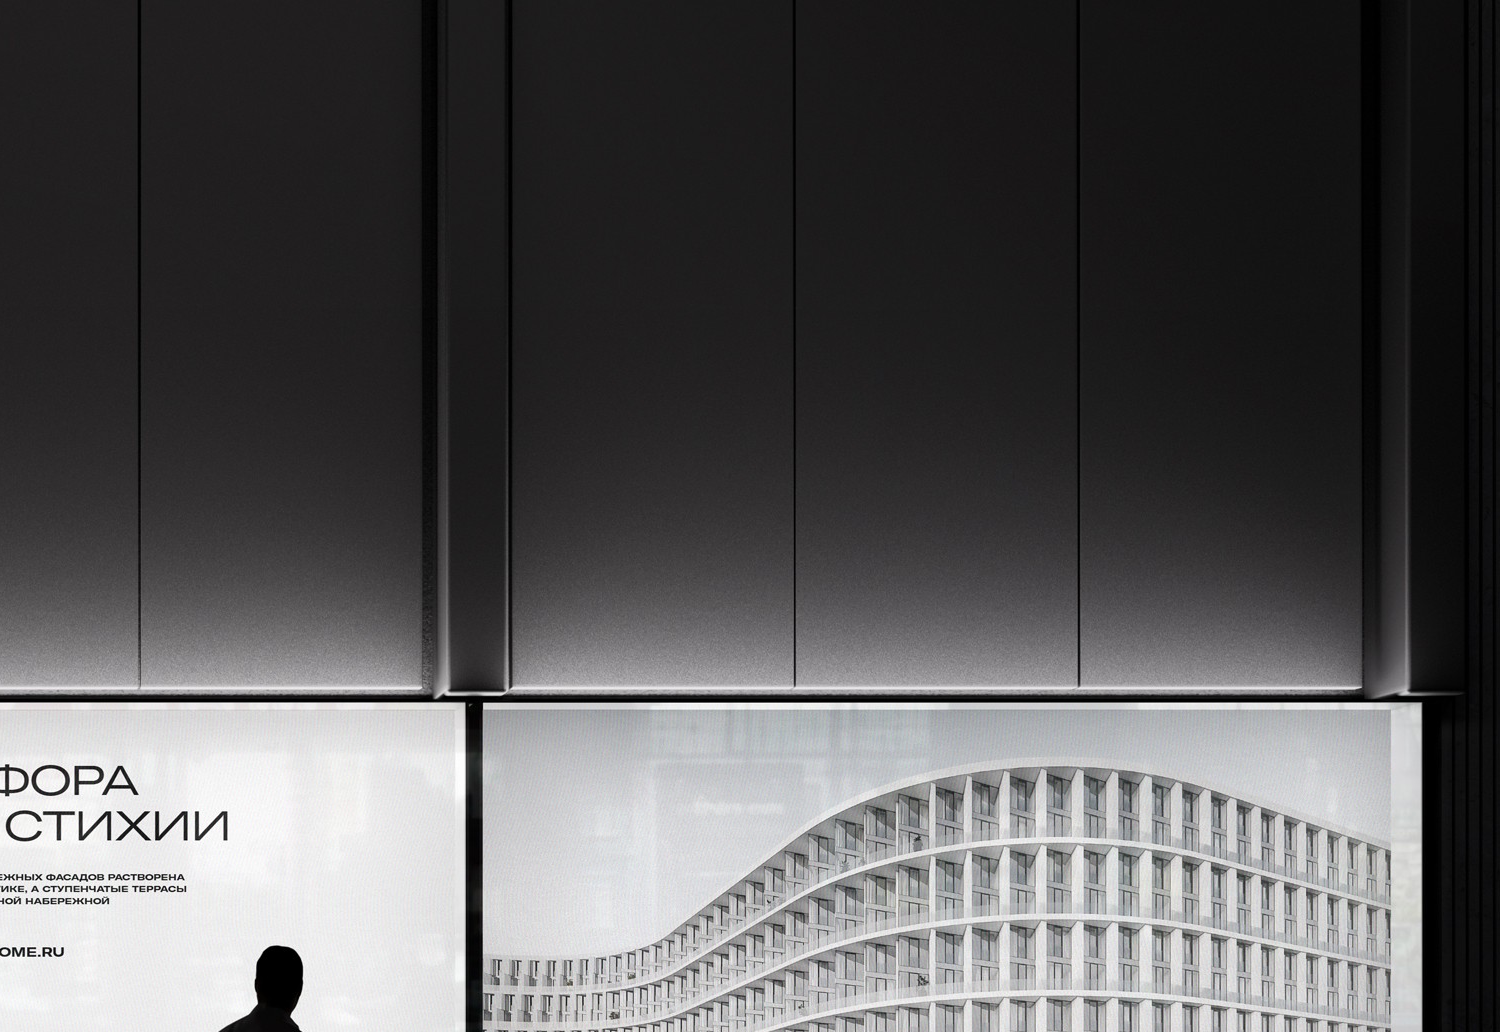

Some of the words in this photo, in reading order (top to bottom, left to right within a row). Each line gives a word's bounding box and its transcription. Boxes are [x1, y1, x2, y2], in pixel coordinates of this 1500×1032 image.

[5, 809, 229, 842] СТИХИИ
[45, 873, 105, 883] ФАСАДОВ
[107, 873, 186, 882] РАСТВОРЕНА
[30, 885, 40, 893] А
[42, 885, 129, 893] СТУПЕНЧАТЫЕ
[131, 885, 187, 893] ТЕРРАСЫ
[25, 896, 110, 905] НАБЕРЕЖНОЙ
